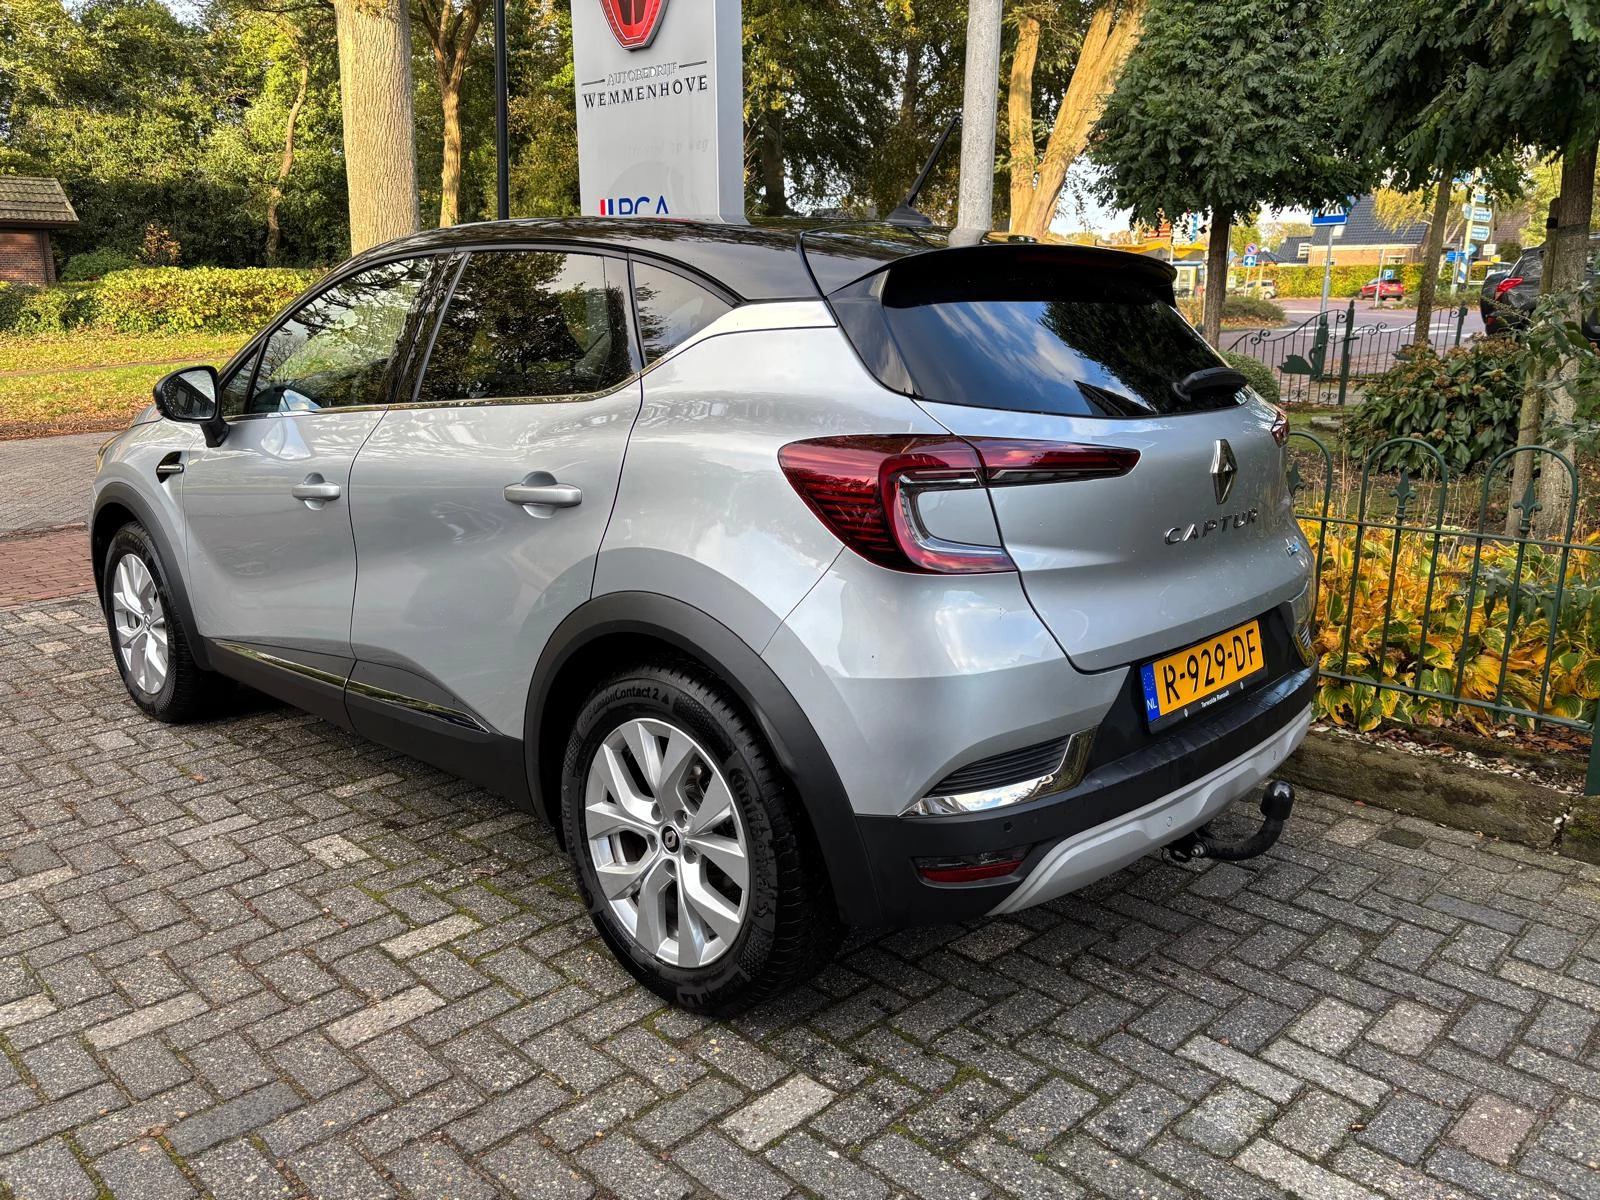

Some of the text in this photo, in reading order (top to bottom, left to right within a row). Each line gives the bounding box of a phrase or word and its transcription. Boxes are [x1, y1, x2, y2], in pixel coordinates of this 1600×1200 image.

[607, 62, 677, 87] AUTOBEDRIJF
[582, 75, 708, 109] WEMMENHOVE
[1164, 508, 1258, 545] CAPTUR
[1163, 629, 1256, 705] R-929-DF
[651, 688, 659, 700] 2
[1146, 698, 1158, 711] NL
